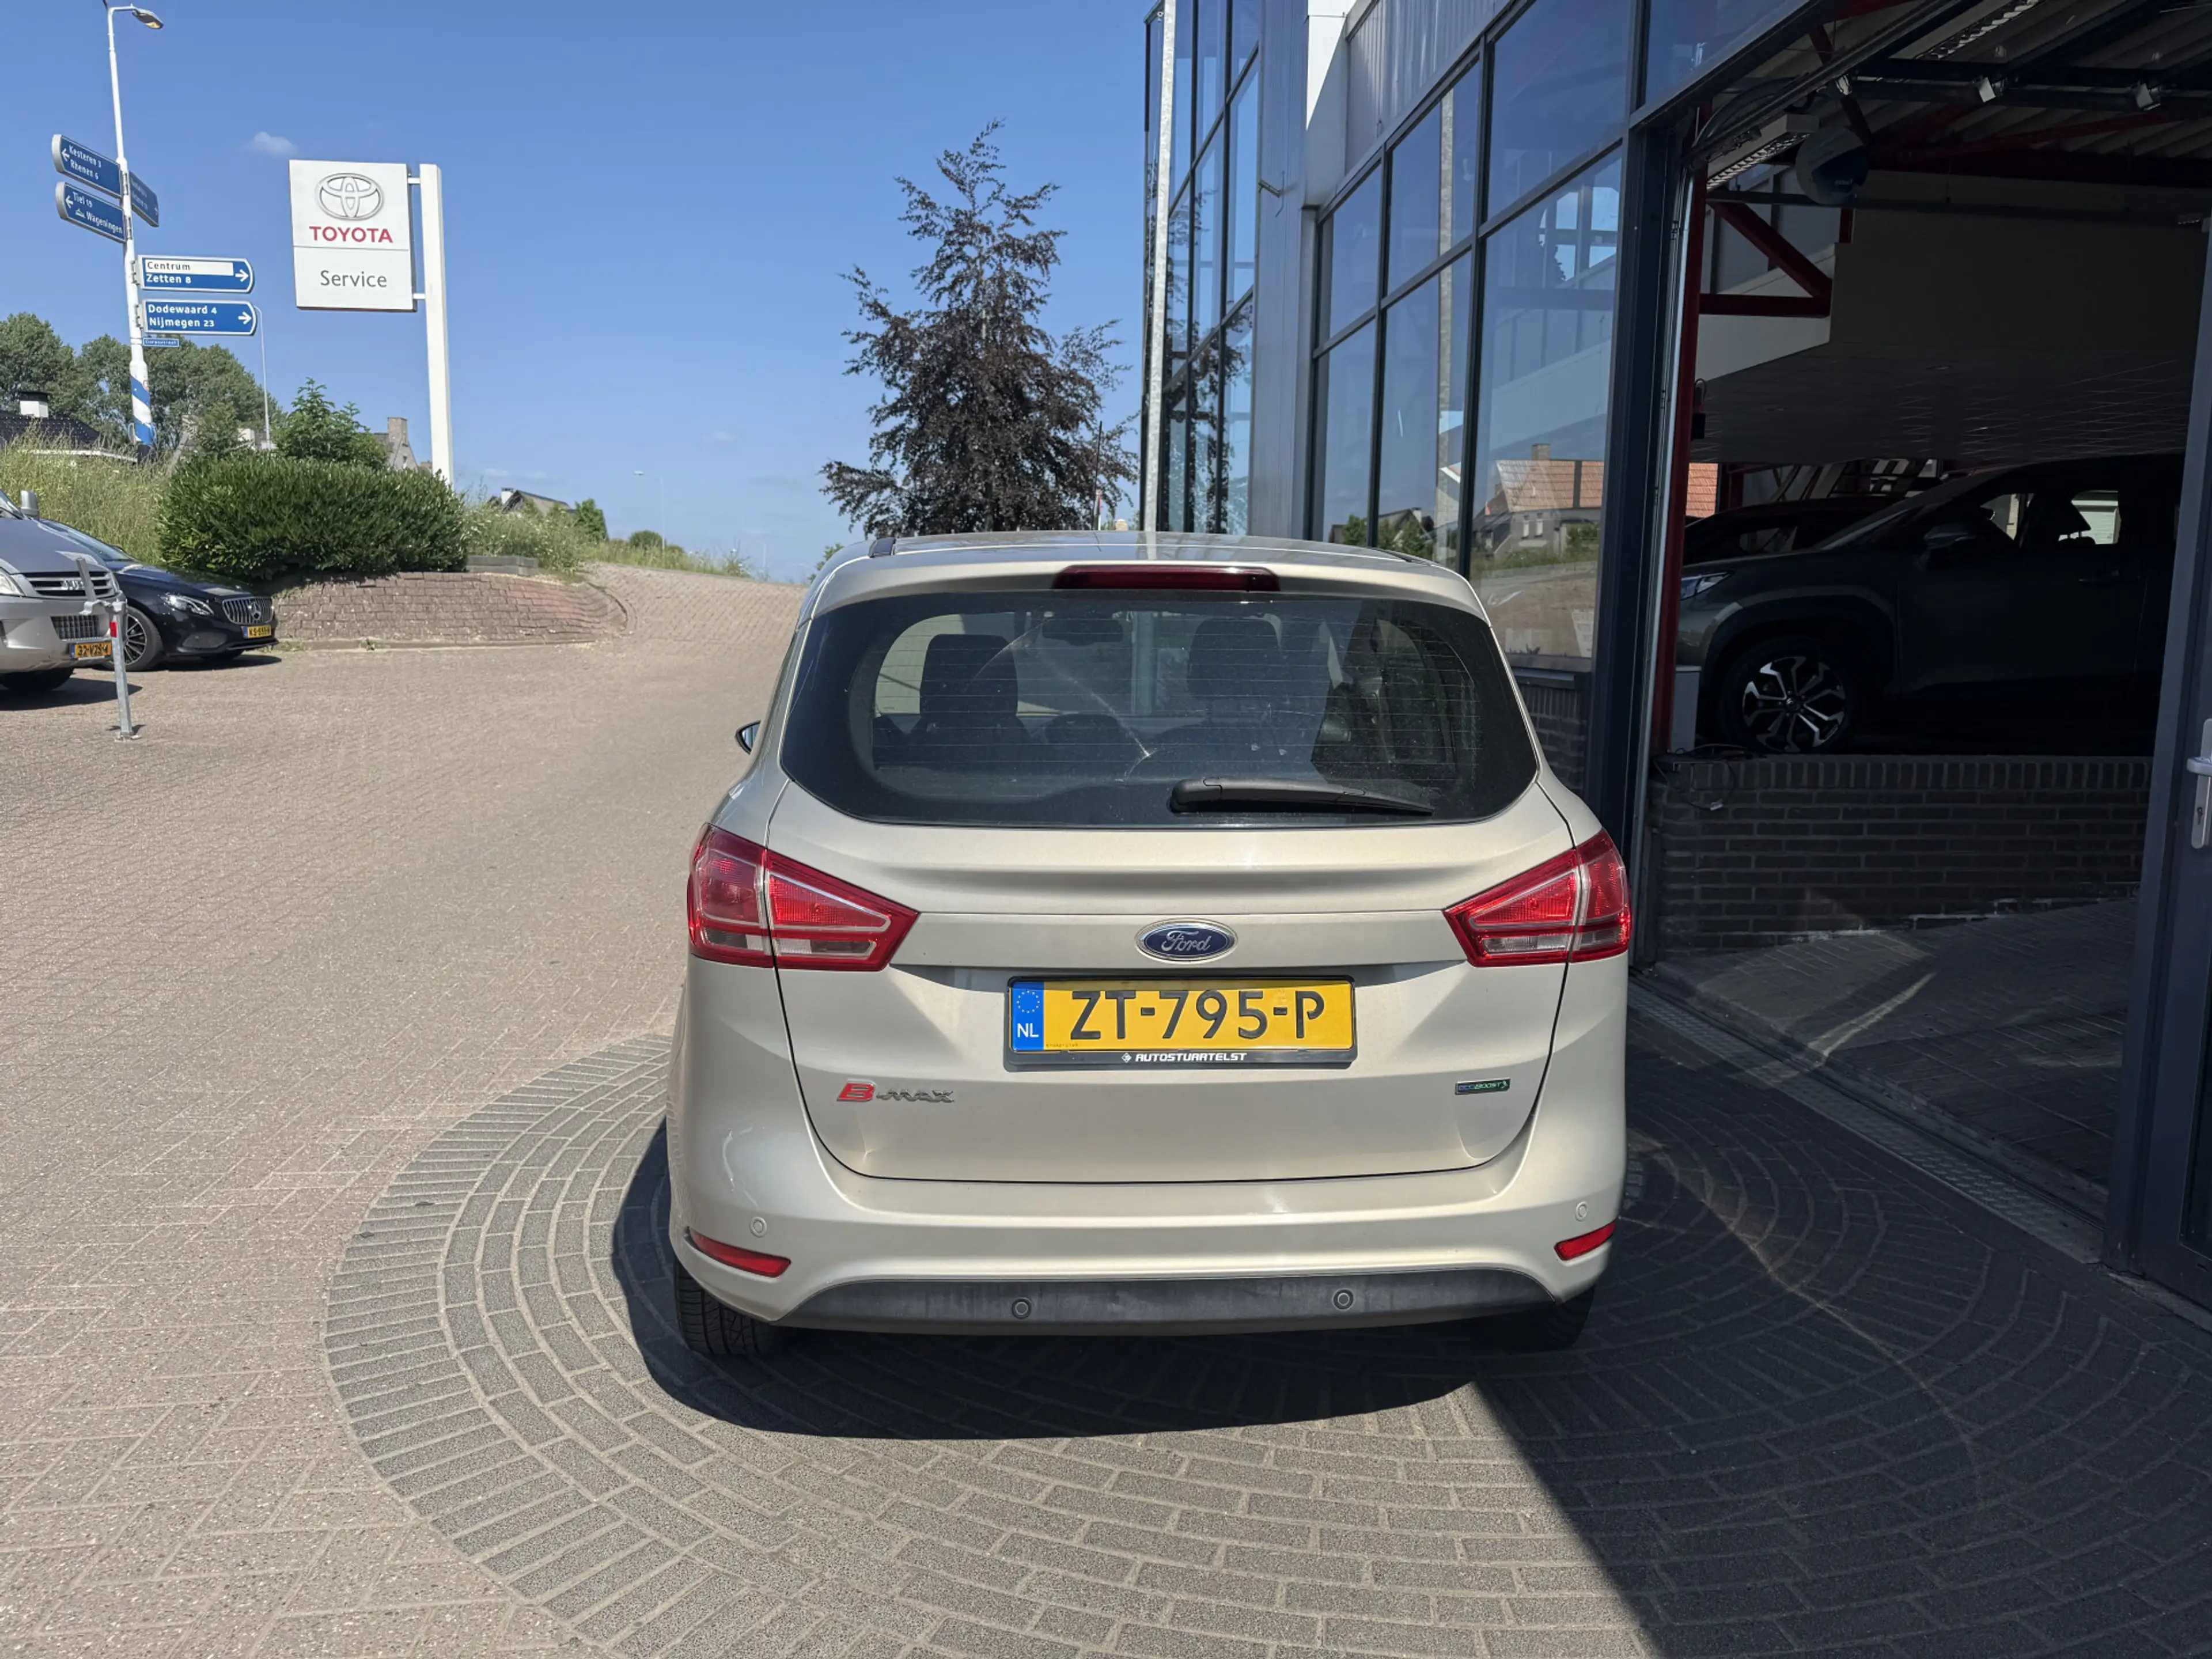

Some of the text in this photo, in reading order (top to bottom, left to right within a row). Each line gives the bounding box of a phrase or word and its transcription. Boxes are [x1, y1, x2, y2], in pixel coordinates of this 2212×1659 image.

[69, 145, 97, 165] Kesteren
[70, 160, 93, 177] Rhenen
[73, 191, 85, 204] Tiel
[86, 211, 123, 233] Wageningen
[309, 226, 393, 243] TOYOTA
[147, 262, 191, 270] Centrum
[146, 274, 181, 283] Zetten
[320, 270, 387, 287] Service
[148, 304, 208, 314] Dodewaard
[149, 317, 200, 329] Nijmegen
[1161, 930, 1212, 952] Ford
[1070, 990, 1325, 1040] ZT-795-P
[1017, 1022, 1039, 1038] NL
